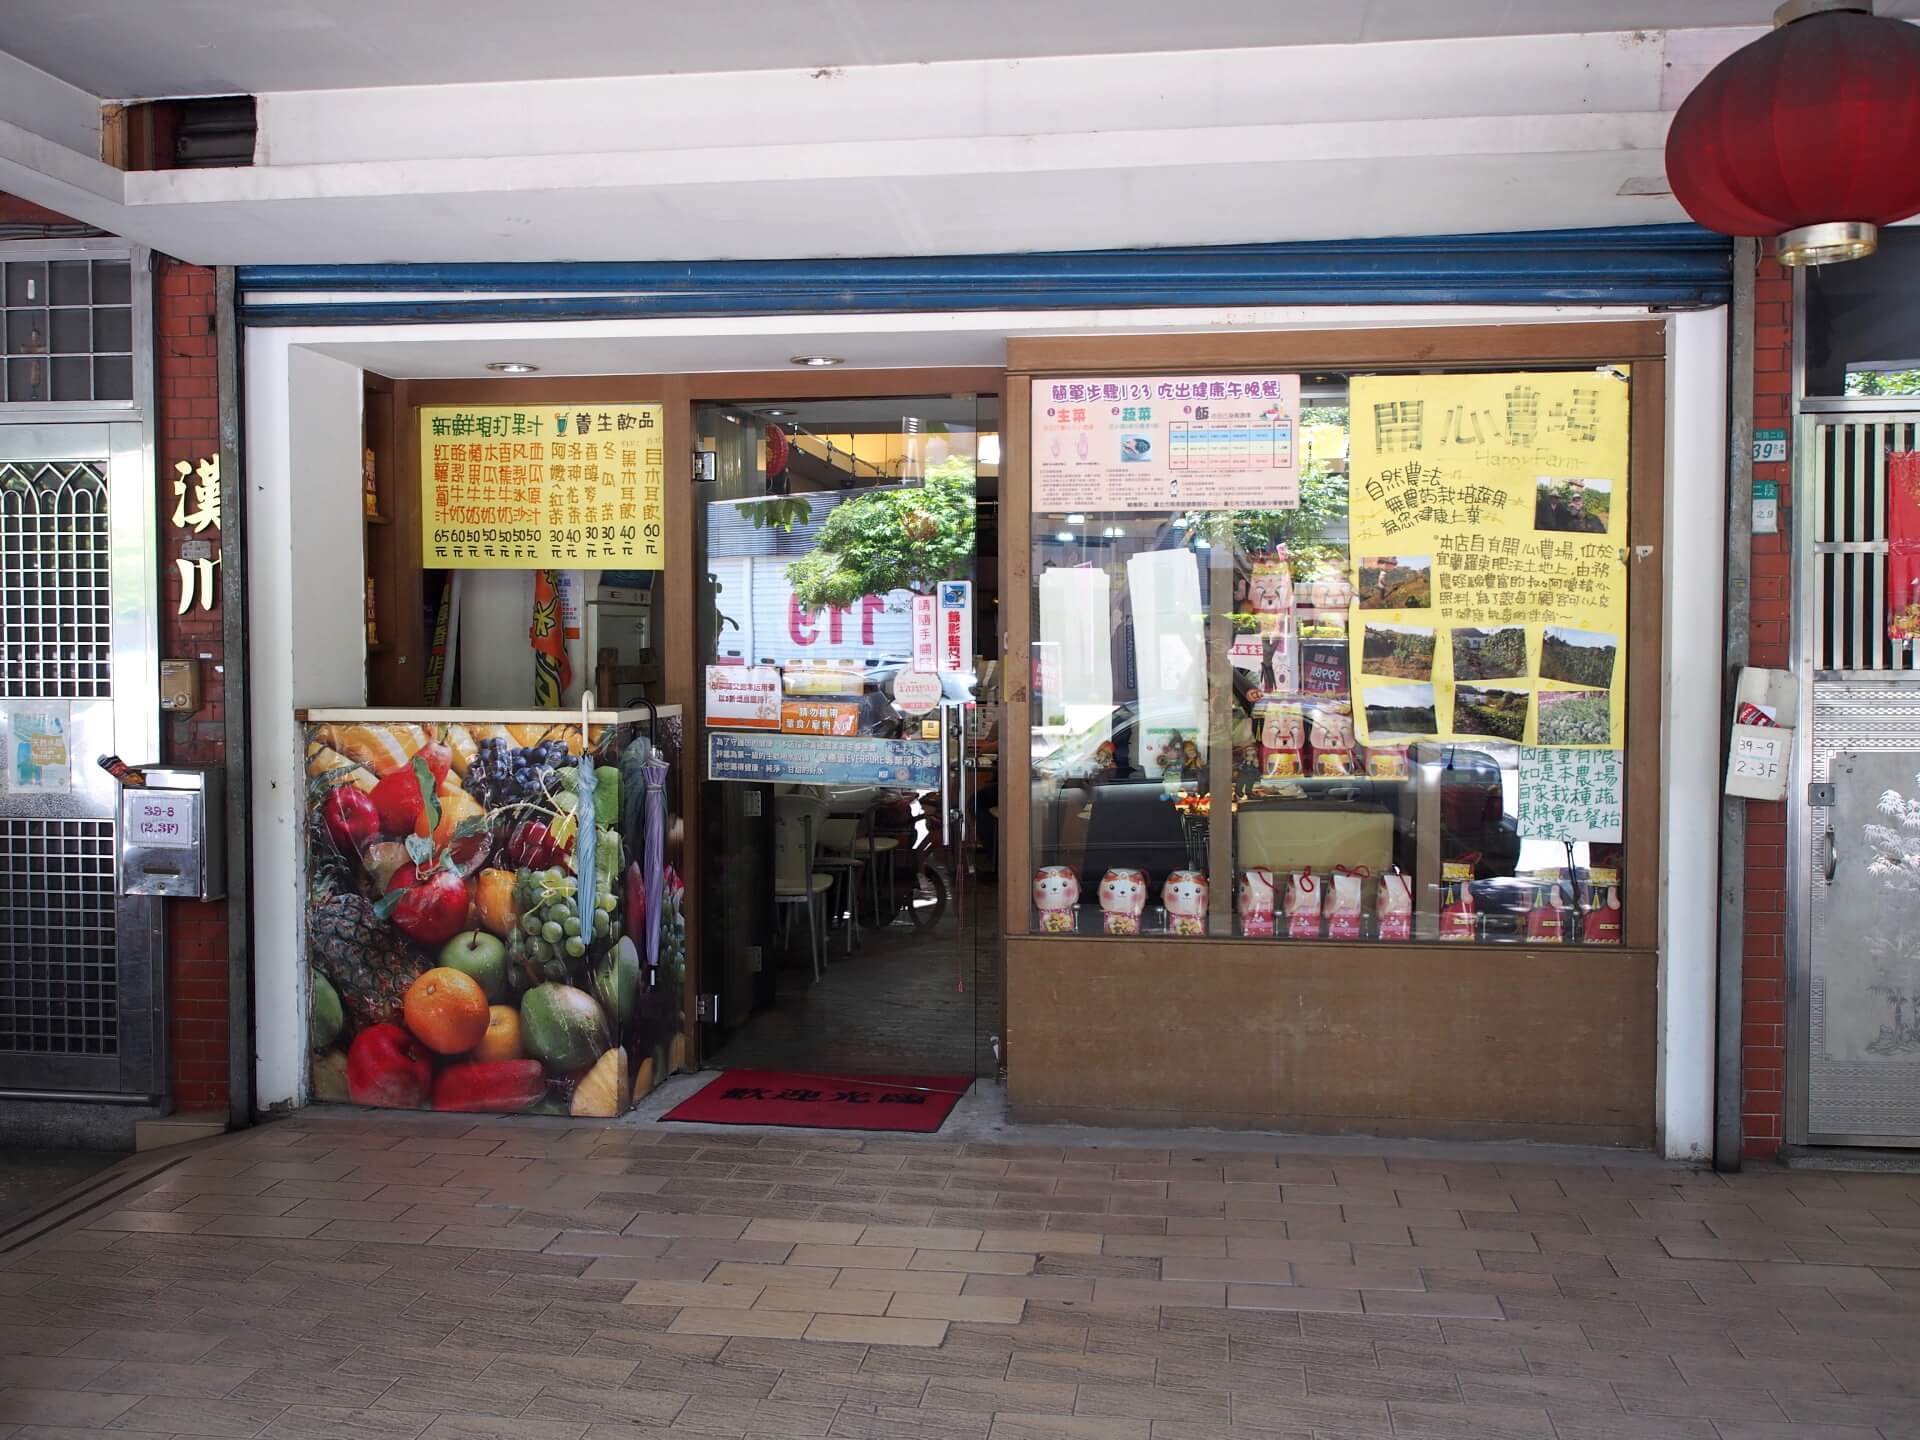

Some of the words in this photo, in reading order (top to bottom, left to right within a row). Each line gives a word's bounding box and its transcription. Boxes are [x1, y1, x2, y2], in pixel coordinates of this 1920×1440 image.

[1057, 408, 1087, 423] 主菜
[1121, 407, 1152, 421] 蔬菜
[1374, 385, 1600, 453] 開心農場
[432, 413, 543, 437] 新鮮現打果汁
[576, 412, 653, 435] 養生飲品
[1753, 443, 1773, 458] 39
[1365, 461, 1443, 501] 自然農法
[144, 806, 175, 817] 39-8
